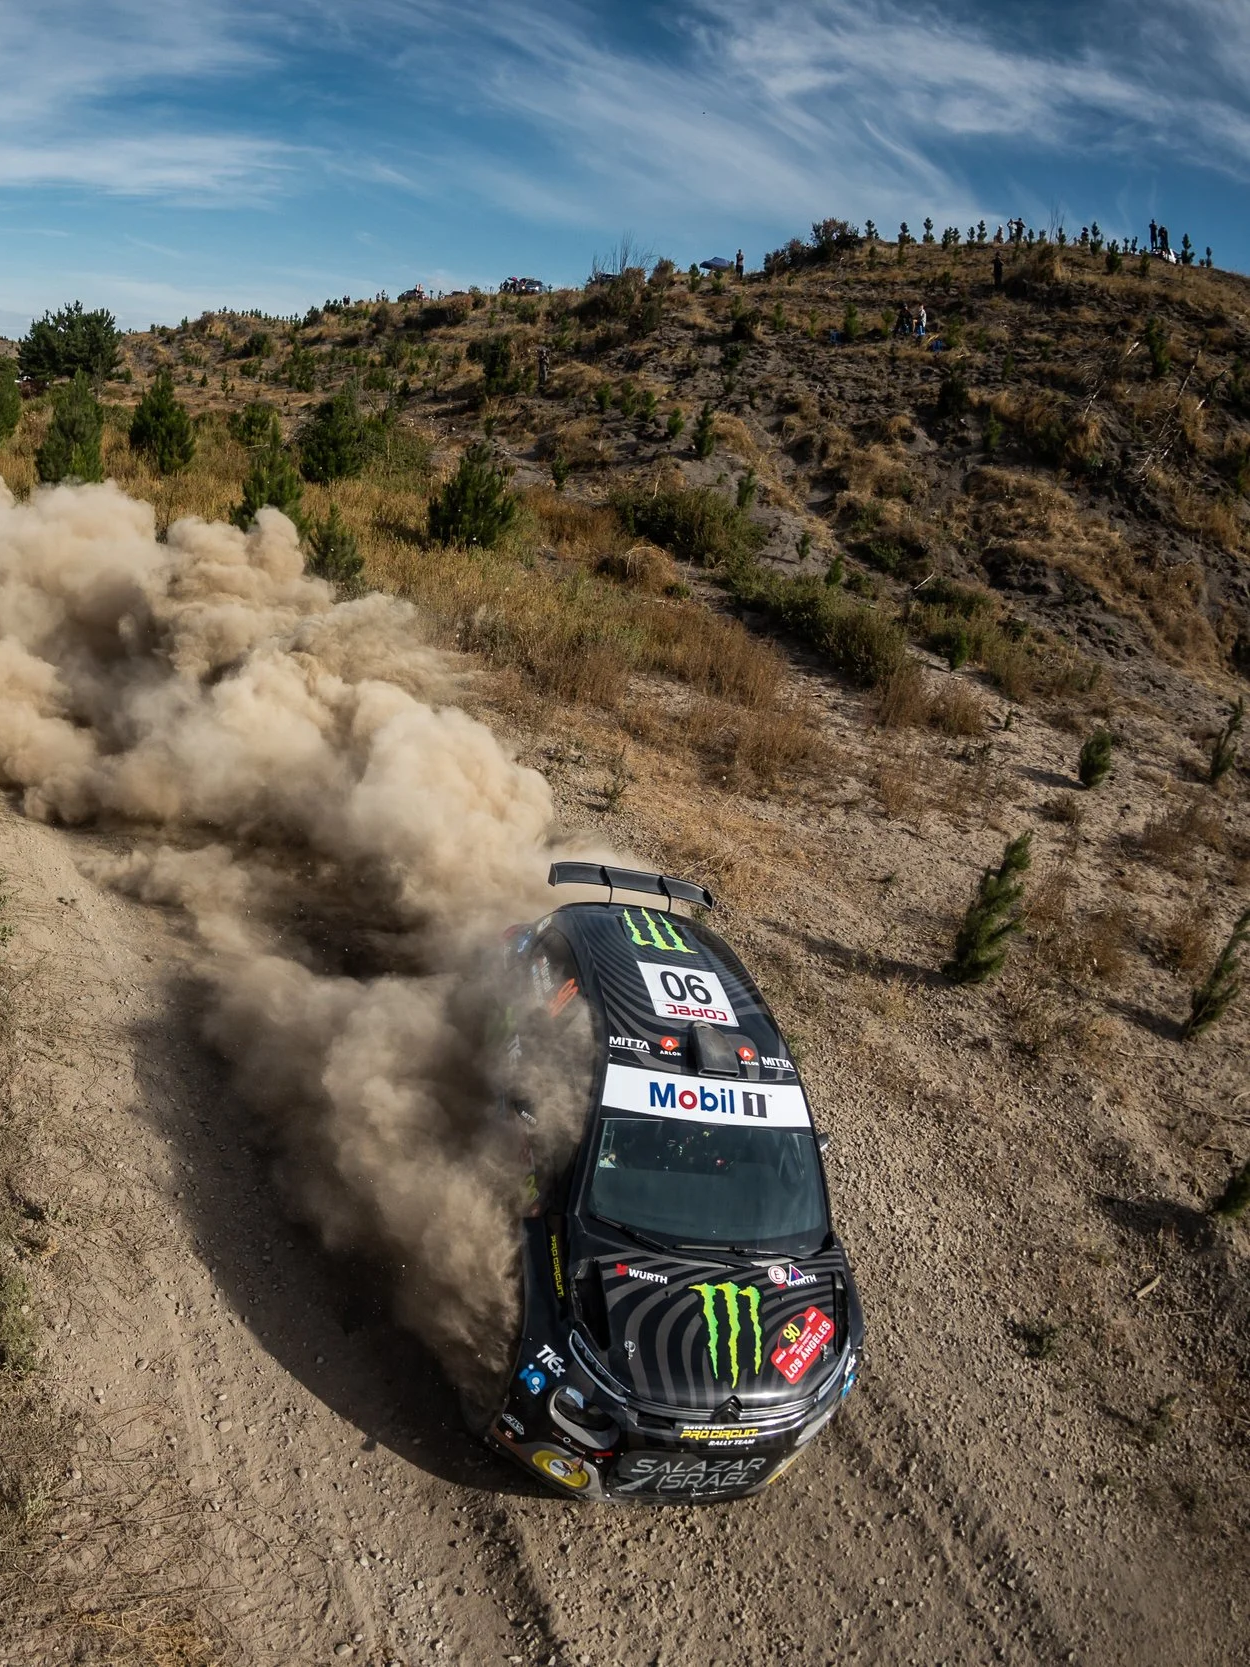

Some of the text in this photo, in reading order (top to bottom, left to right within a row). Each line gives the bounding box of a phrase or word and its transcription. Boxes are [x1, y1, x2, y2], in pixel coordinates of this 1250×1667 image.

[665, 1004, 728, 1021] COPEC
[609, 1036, 650, 1050] MITTA
[761, 1056, 795, 1069] MITTA
[649, 1082, 735, 1114] Mobil
[553, 1257, 565, 1297] CIRCUIT
[783, 1323, 801, 1343] 90
[785, 1358, 803, 1379] LOS
[680, 1429, 759, 1440] PRO CIRCUIT
[630, 1457, 767, 1473] SALAZAR
[655, 1472, 750, 1489] ISRAEL
